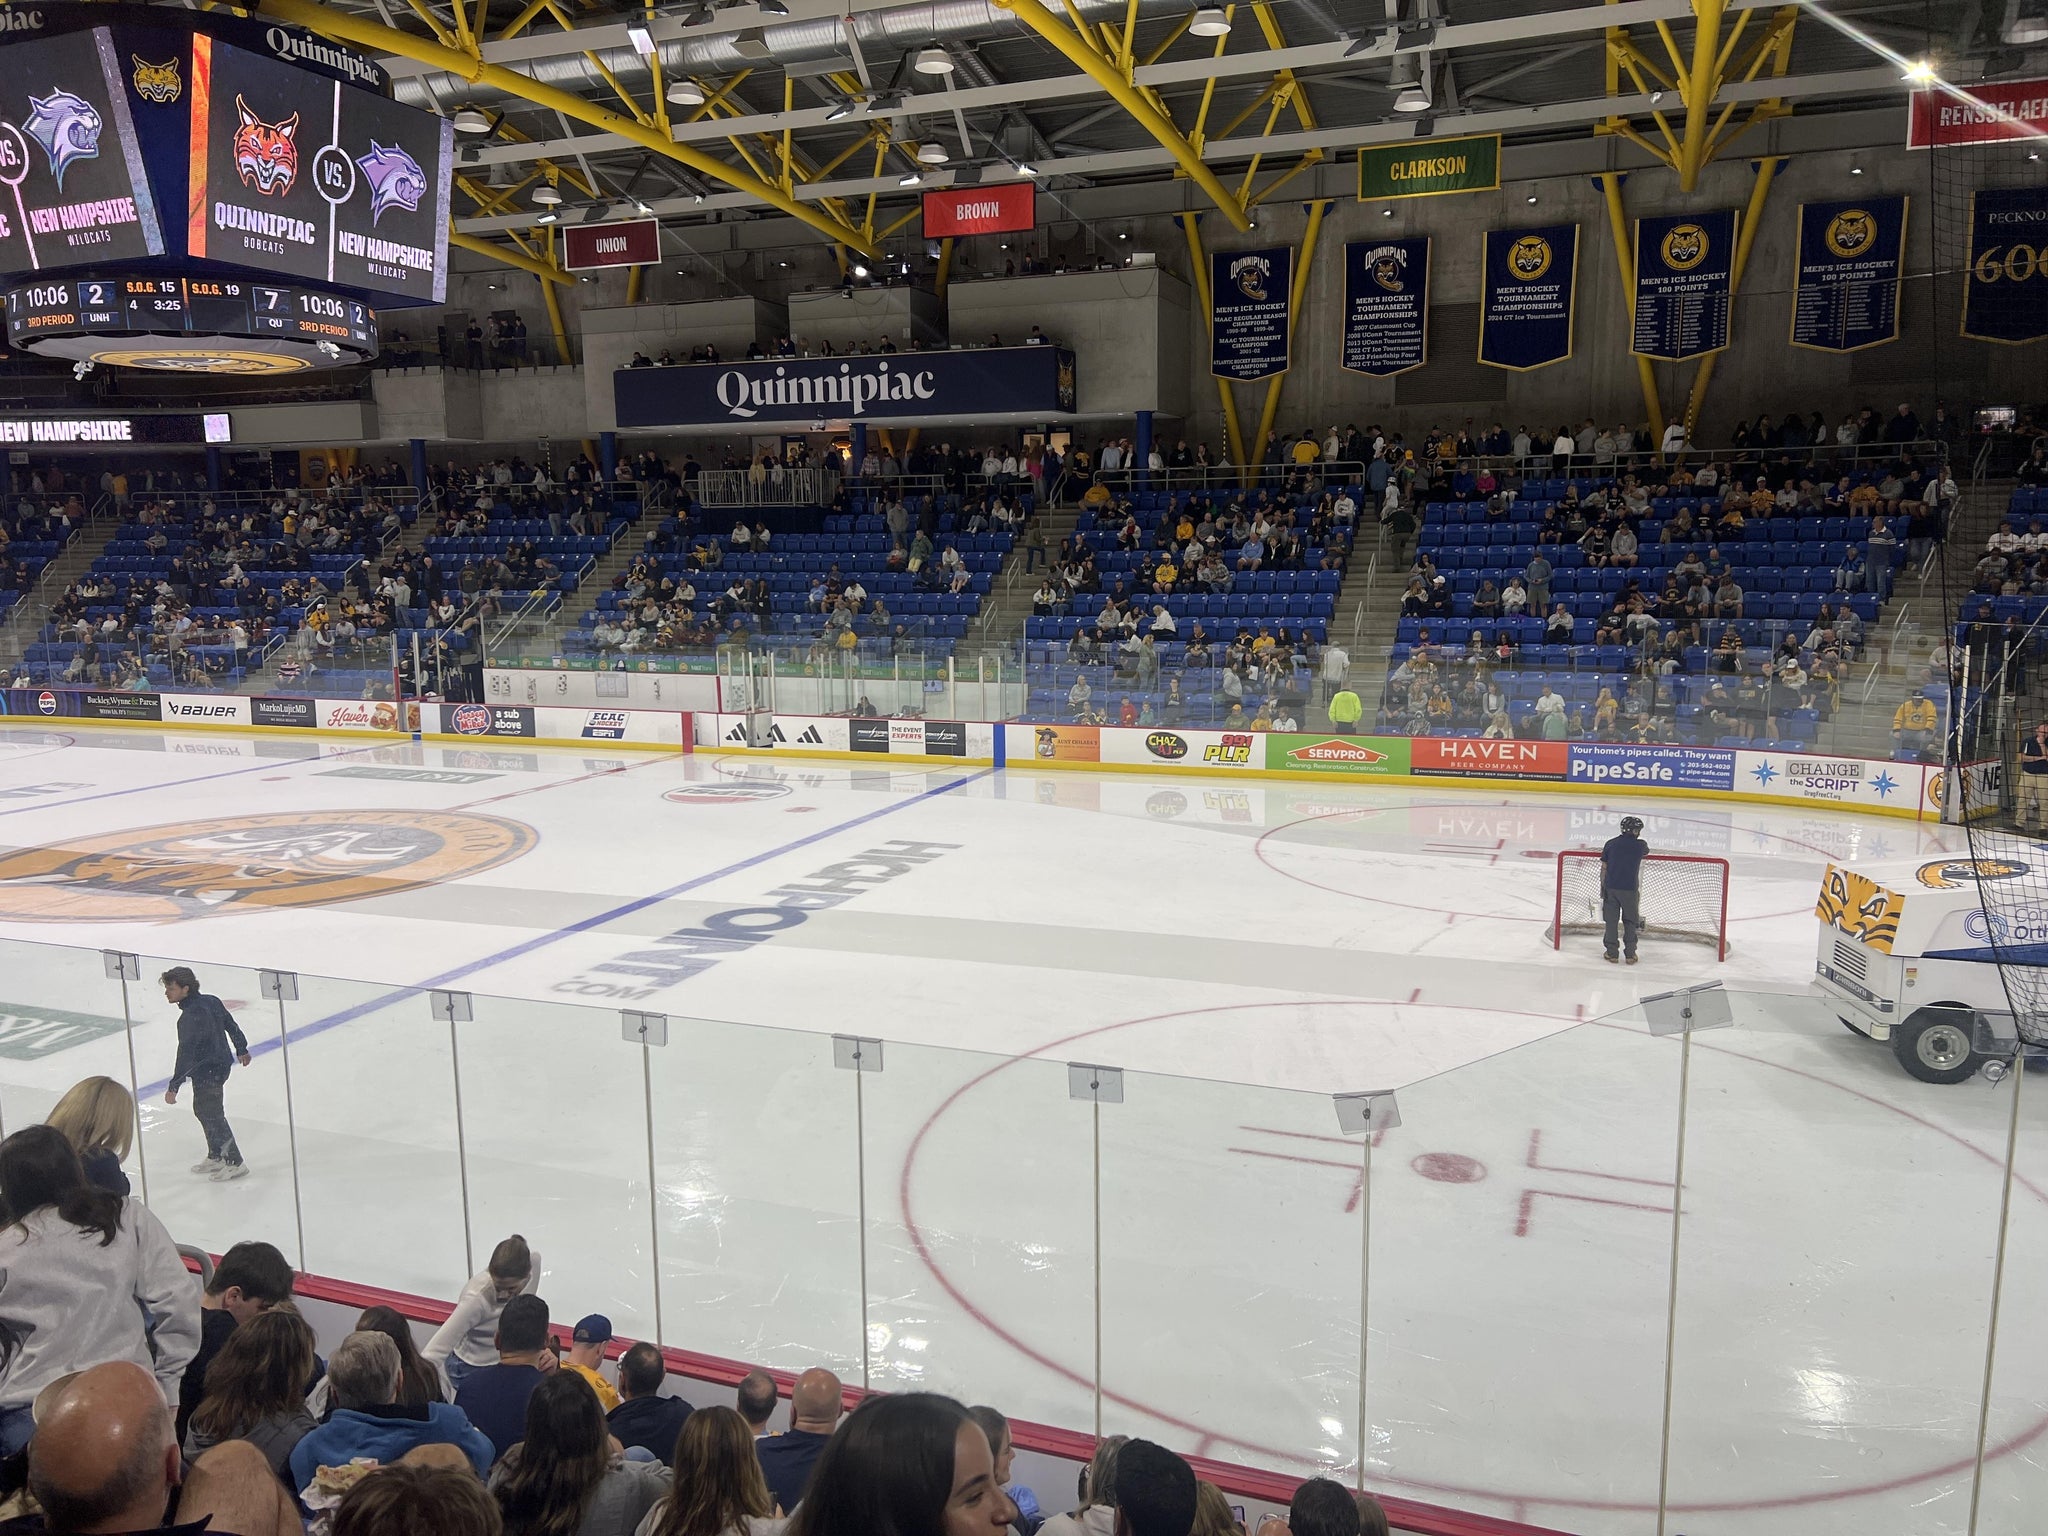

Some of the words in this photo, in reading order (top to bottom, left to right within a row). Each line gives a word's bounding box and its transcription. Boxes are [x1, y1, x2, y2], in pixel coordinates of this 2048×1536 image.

[266, 27, 380, 86] Quinnipiac
[1390, 155, 1467, 181] CLARKSON
[323, 164, 346, 188] VS.
[29, 207, 60, 234] NEW
[58, 197, 138, 230] HAMPSHIRE
[956, 201, 1000, 221] BROWN
[1988, 210, 2048, 224] PECKNO
[214, 201, 316, 245] QUINNIPIAC
[67, 230, 112, 247] WILDCATS
[243, 236, 285, 255] BOBCATS
[595, 236, 628, 254] UNION
[338, 230, 367, 258] NEW
[366, 237, 434, 272] HAMPSHIRE
[1364, 246, 1408, 271] QUINNIPIAC
[367, 262, 407, 280] WILDCATS
[1230, 256, 1271, 280] QUINNIPIAC
[1803, 264, 1834, 273] MEN'S
[1835, 263, 1853, 271] ICE
[1854, 260, 1896, 270] HOCKEY
[1641, 277, 1669, 285] MEN'S
[1670, 275, 1687, 283] ICE
[1688, 272, 1727, 282] HOCKEY
[1839, 271, 1876, 280] POINTS
[88, 284, 104, 304] 2
[126, 282, 157, 293] S.O.G.
[160, 281, 176, 293] 15
[192, 284, 222, 295] S.O.G.
[225, 284, 240, 296] 19
[1496, 286, 1523, 294] MEN'S
[1524, 285, 1561, 293] HOCKEY
[1674, 283, 1709, 292] POINTS
[26, 286, 69, 308] 10:06
[264, 291, 279, 310] 7
[1355, 297, 1381, 305] MEN'S
[1382, 294, 1415, 303] HOCKEY
[1497, 294, 1559, 303] TOURNAMENT
[129, 301, 138, 310] 4
[154, 300, 181, 311] 3:25
[300, 295, 344, 318] 10:06
[1216, 306, 1239, 314] MEN'S
[1254, 302, 1286, 311] HOCKEY
[1357, 303, 1414, 313] TOURNAMENT
[1492, 302, 1563, 312] CHAMPIONSHIPS
[27, 317, 41, 328] 3RD
[42, 314, 75, 326] PERIOD
[90, 313, 110, 323] UNH
[355, 305, 364, 324] 2
[1351, 311, 1419, 321] CHAMPIONSHIPS
[268, 318, 283, 328] QU
[299, 320, 319, 332] 3RD
[319, 324, 349, 337] PERIOD
[1232, 319, 1269, 327] CHAMPIONS
[1231, 341, 1269, 349] CHAMPIONS
[716, 361, 936, 418] Quinnipiac
[31, 420, 132, 441] HAMPSHIRE
[327, 706, 370, 727] Haven
[456, 709, 485, 722] Jersey
[495, 710, 502, 718] a
[503, 709, 520, 719] sub
[593, 712, 625, 721] ECAC
[495, 721, 522, 730] above
[592, 729, 615, 737] ESPN
[1148, 735, 1177, 746] CHAZ
[1203, 745, 1250, 762] PLR
[1441, 742, 1537, 760] HAVEN
[1573, 746, 1593, 755] Your
[1594, 748, 1625, 756] home's
[1626, 749, 1651, 758] pipes
[1653, 750, 1683, 758] called.
[1684, 751, 1706, 760] They
[1478, 762, 1525, 770] COMPANY
[1572, 759, 1674, 782] PipeSafe
[1789, 763, 1859, 776] CHANGE
[1805, 778, 1859, 792] SCRIPT
